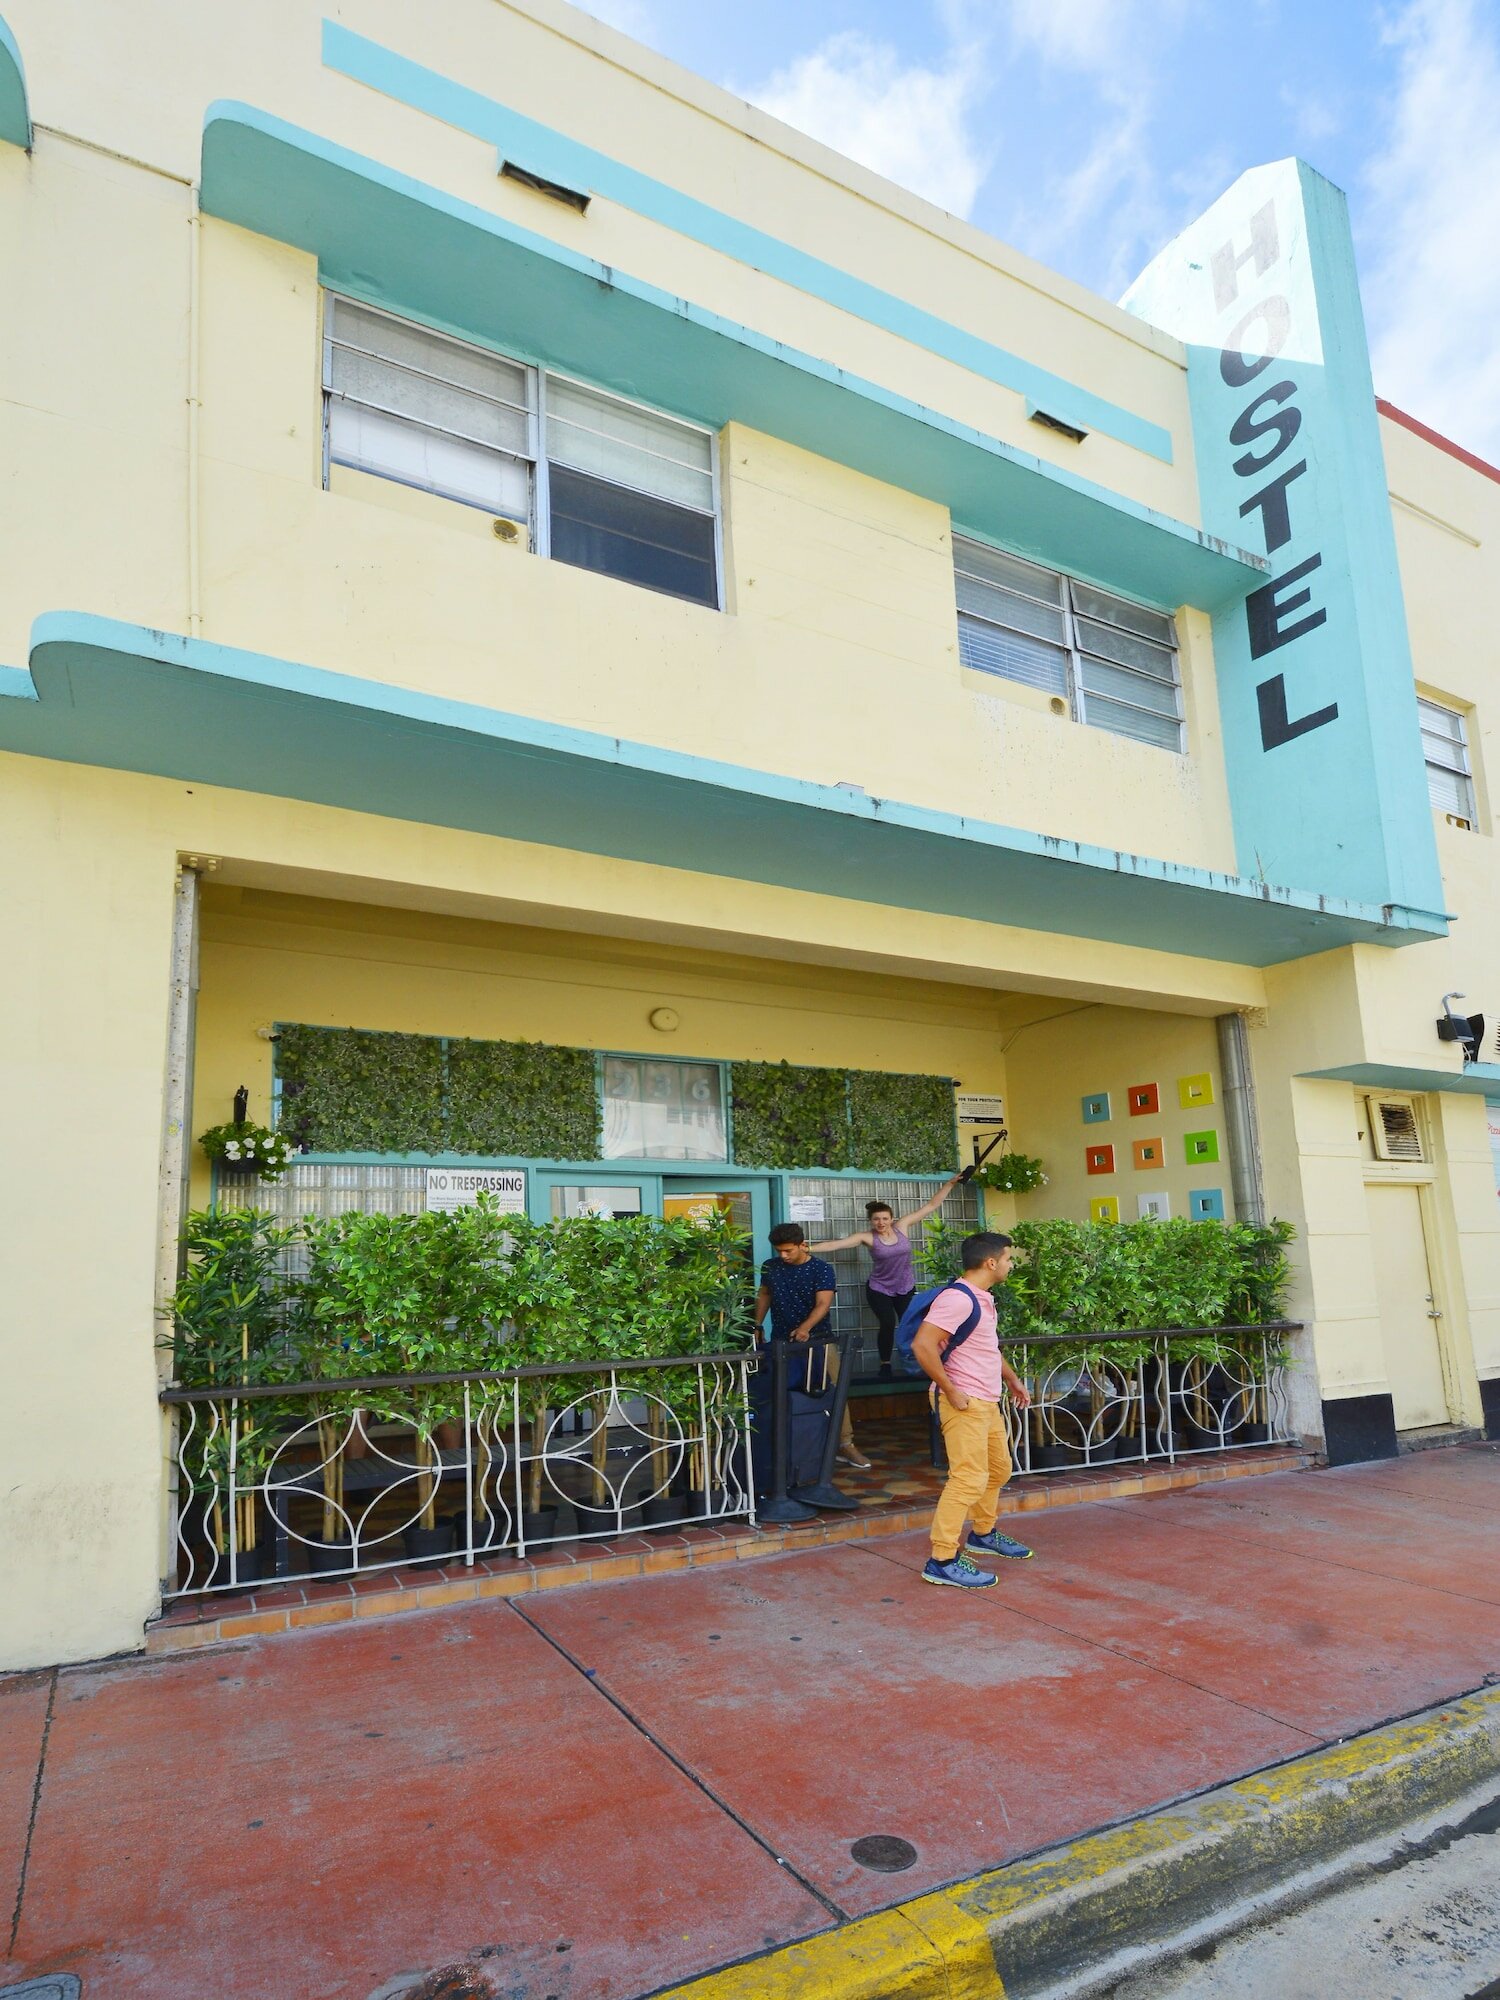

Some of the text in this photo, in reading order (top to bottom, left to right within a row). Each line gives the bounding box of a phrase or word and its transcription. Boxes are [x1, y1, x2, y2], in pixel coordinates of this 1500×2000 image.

[1211, 198, 1339, 753] HOSTEL
[429, 1175, 523, 1192] NO TRESPASSING
